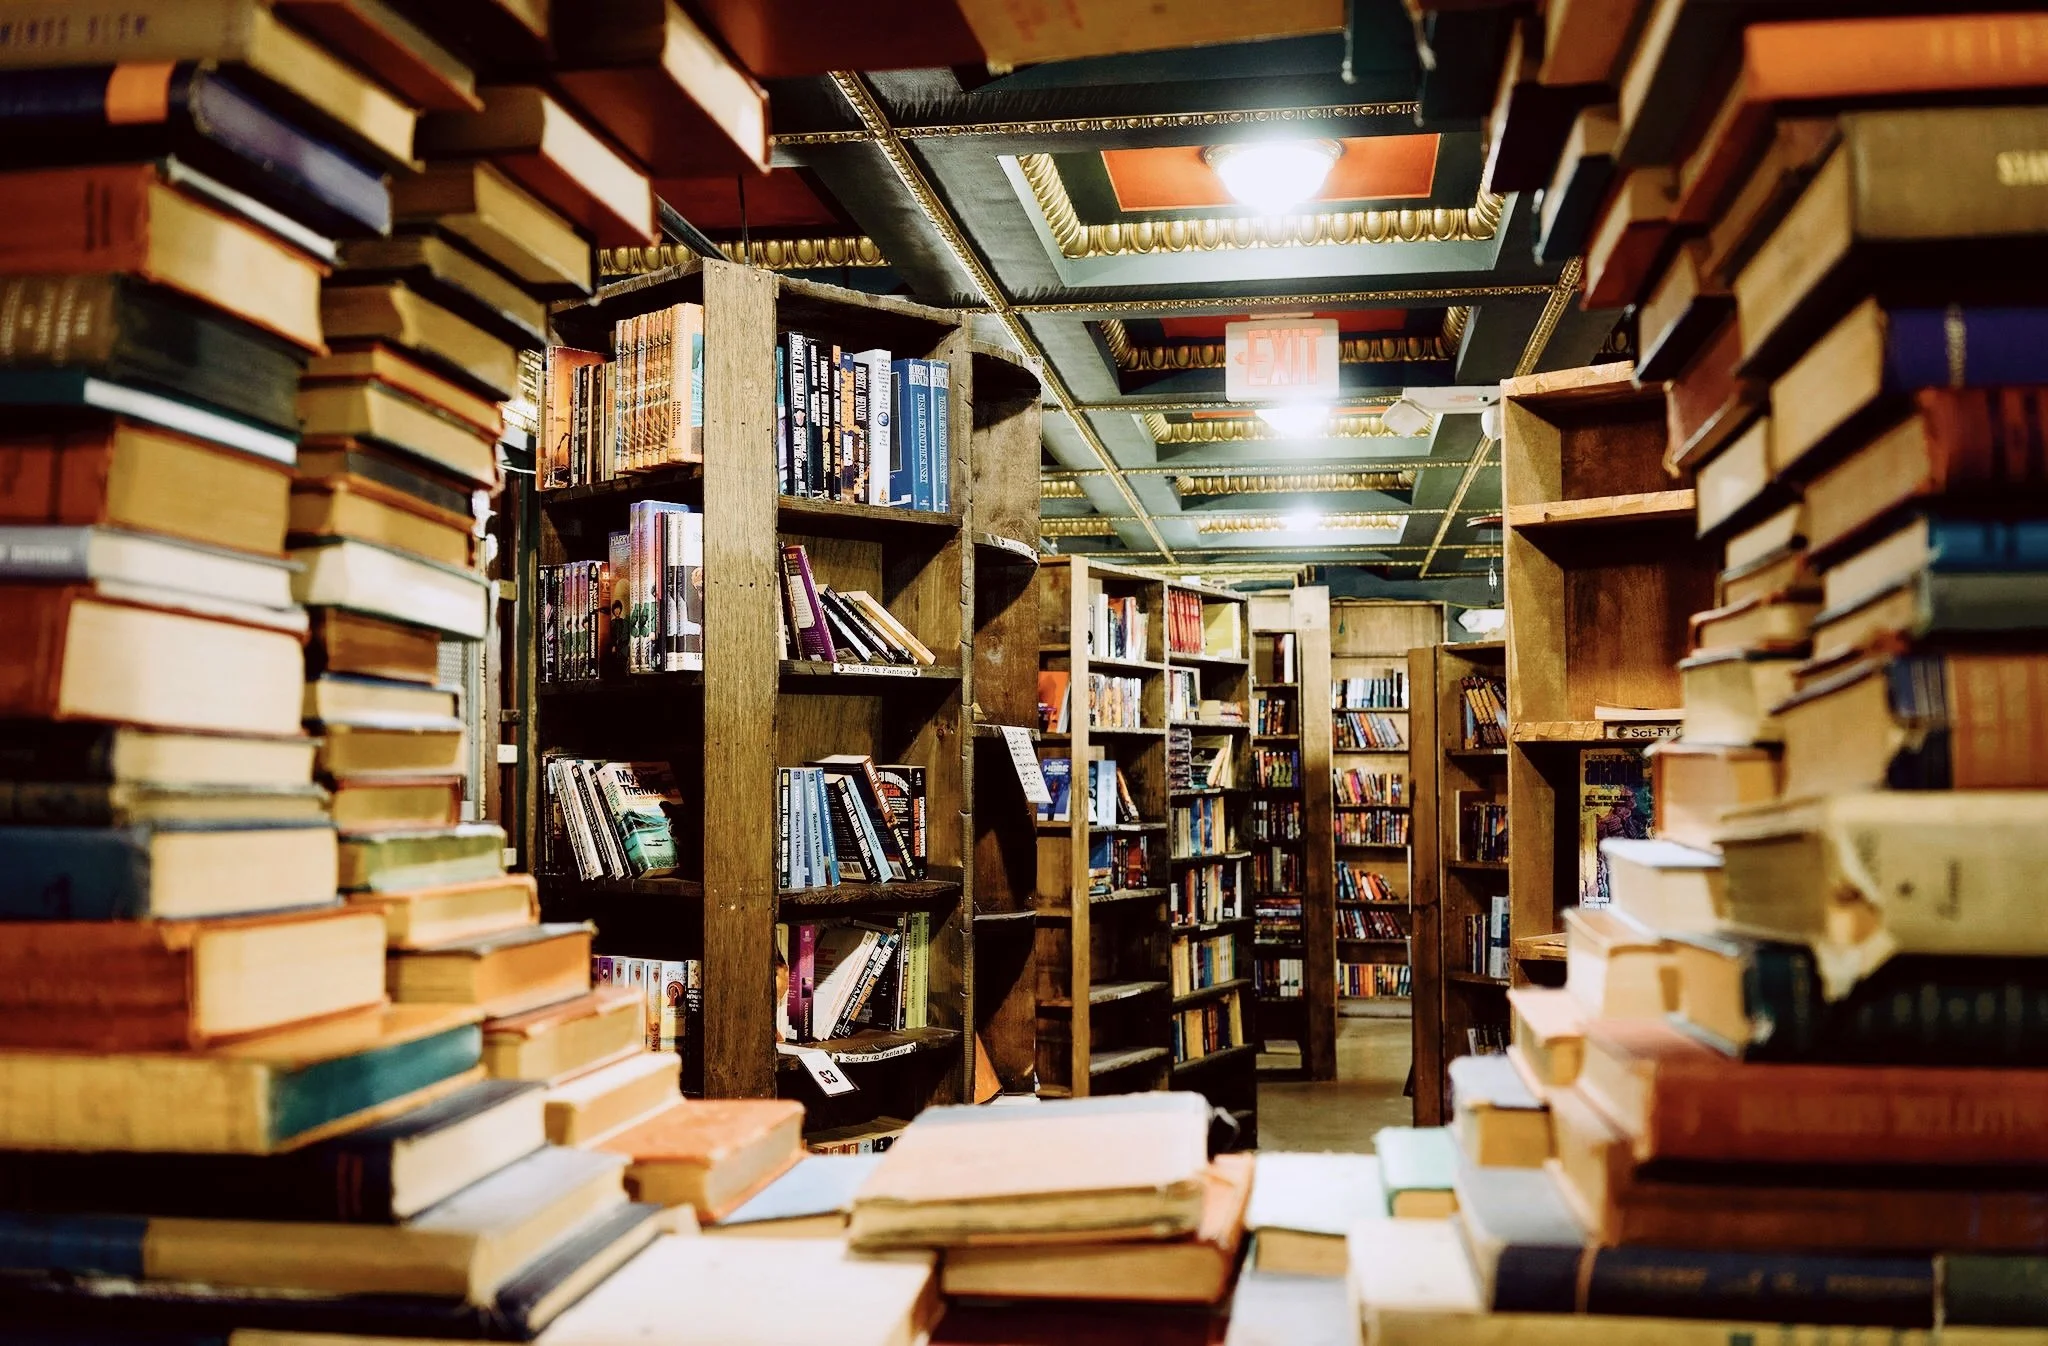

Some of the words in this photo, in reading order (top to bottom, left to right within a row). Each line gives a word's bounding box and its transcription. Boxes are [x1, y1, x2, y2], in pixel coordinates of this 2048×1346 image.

[791, 333, 805, 365] ROBERT
[1248, 328, 1325, 386] EXIT
[855, 366, 866, 388] ROBERT
[794, 372, 805, 410] HEINLEIN
[856, 394, 867, 421] HEINLEIN
[610, 534, 630, 546] HARRY
[882, 668, 912, 676] Fantasy
[1631, 728, 1670, 738] Sci-Fi
[616, 770, 634, 786] My
[842, 792, 853, 810] ROBERT
[850, 814, 863, 838] HEINLEIN
[866, 761, 878, 784] ROBERT
[877, 790, 890, 814] HEINLEIN
[902, 850, 913, 868] ROAD
[874, 946, 893, 977] HEINLEIN
[857, 968, 870, 988] Robert
[842, 994, 856, 1019] Heinlein
[882, 1047, 908, 1058] Fantasy
[818, 1069, 839, 1085] $3
